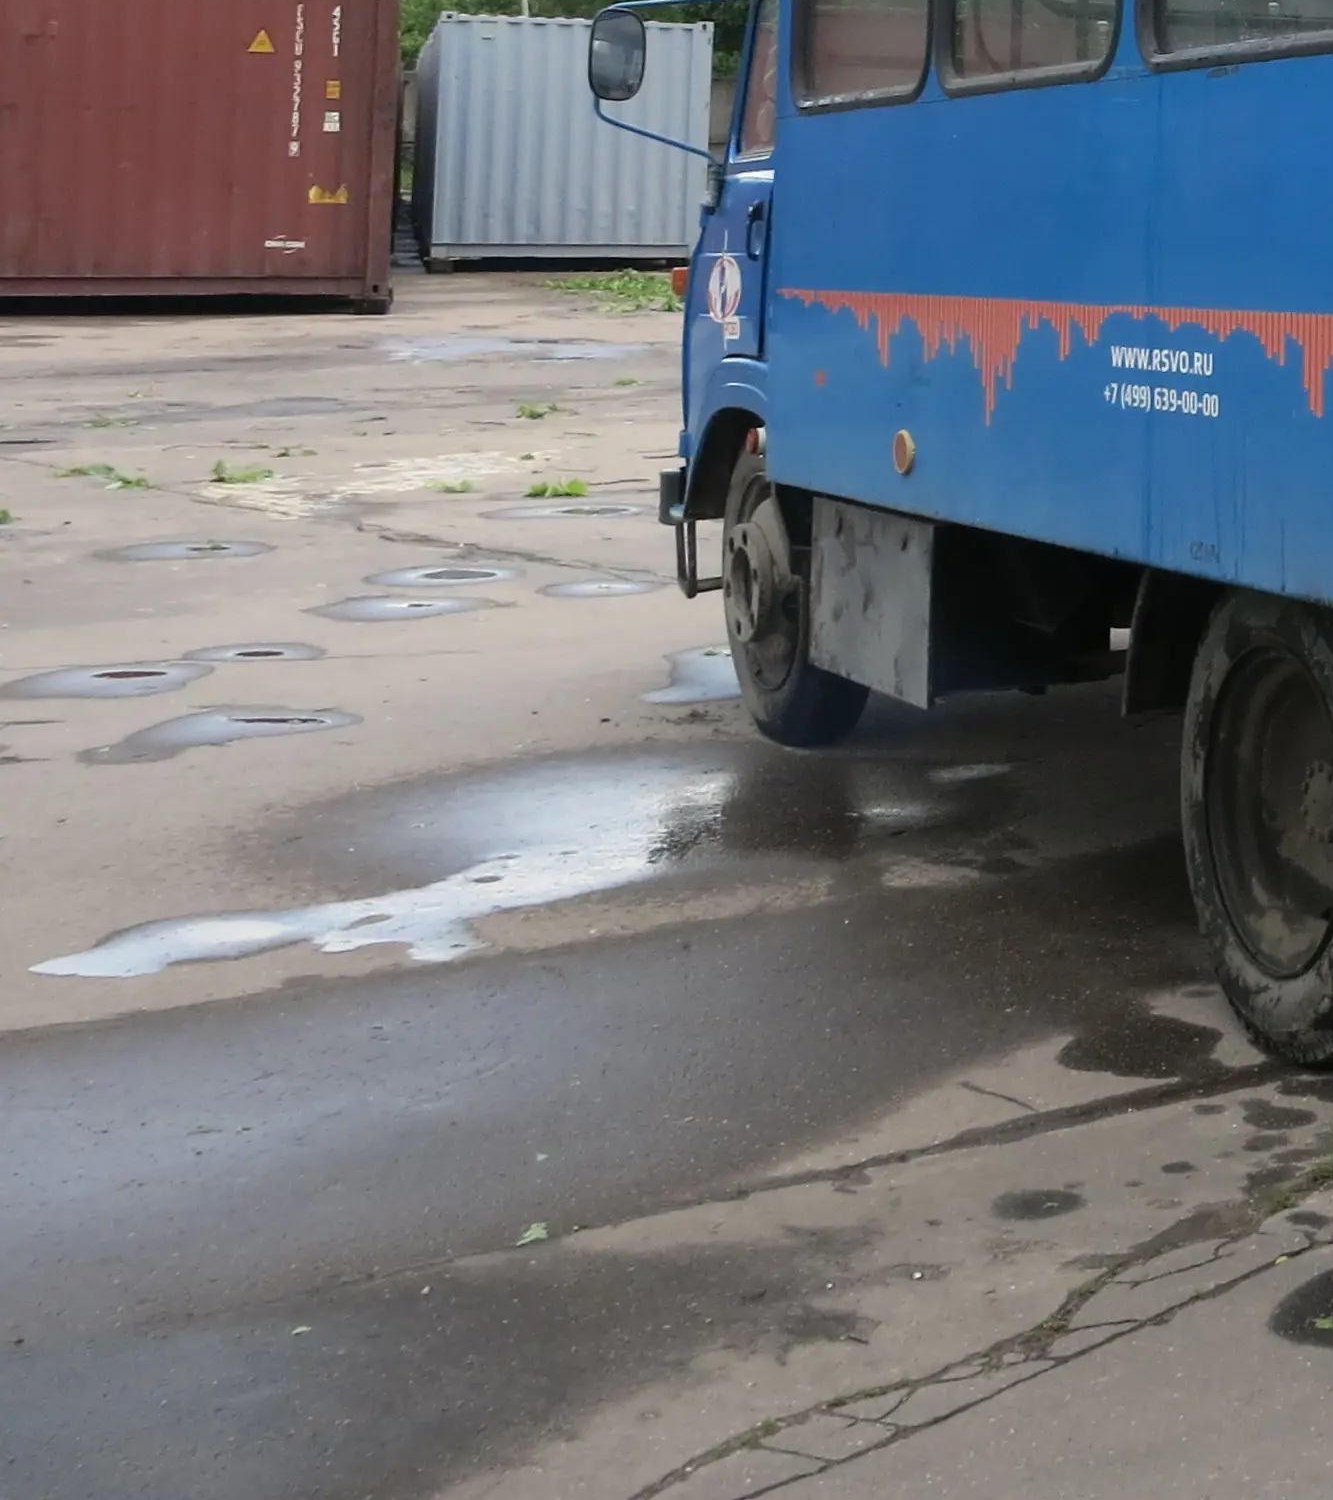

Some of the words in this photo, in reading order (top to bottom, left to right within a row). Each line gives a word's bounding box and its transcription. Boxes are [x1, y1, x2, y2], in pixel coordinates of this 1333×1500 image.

[1110, 345, 1214, 376] WWW.RSVO.RU
[1103, 383, 1119, 404] +7
[1120, 383, 1152, 412] (499)
[1153, 387, 1219, 417] 639-00-00
